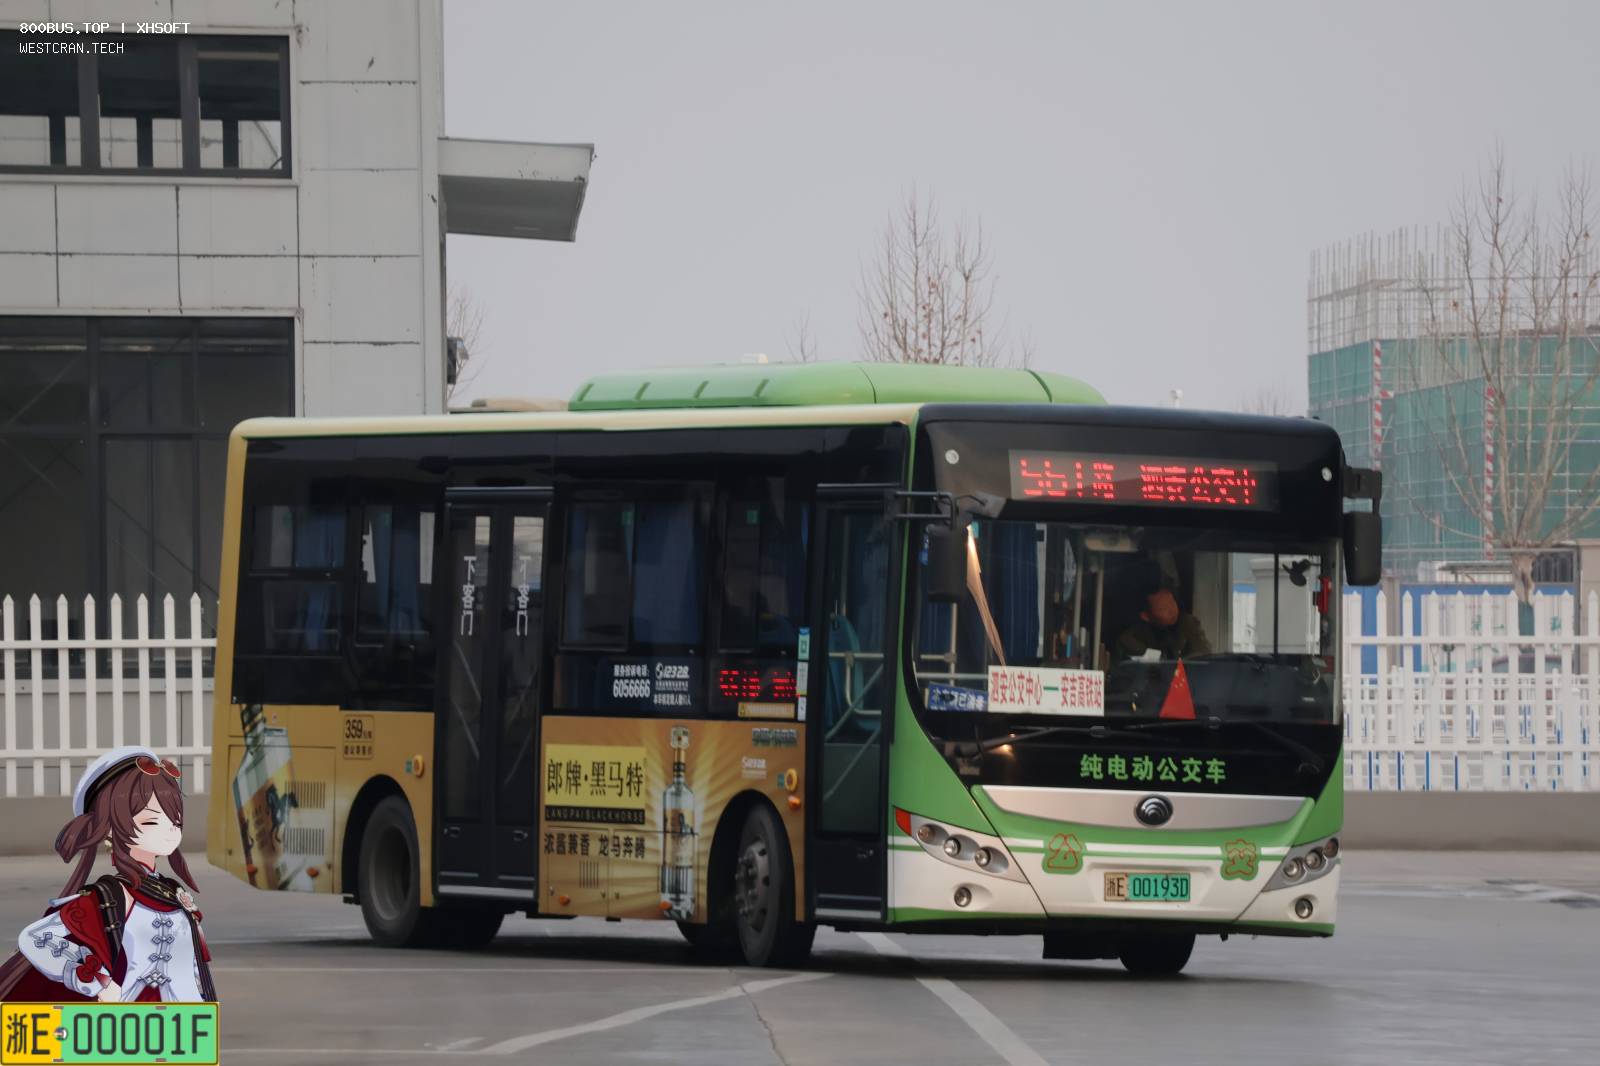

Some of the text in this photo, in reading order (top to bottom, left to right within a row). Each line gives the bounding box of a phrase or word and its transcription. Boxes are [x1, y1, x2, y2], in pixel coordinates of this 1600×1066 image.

[612, 679, 651, 698] 6056666
[345, 719, 363, 739] 359
[1079, 754, 1227, 784] 纯电动公交车
[598, 834, 646, 860] 龙马奔腾
[1132, 875, 1189, 898] 00193D
